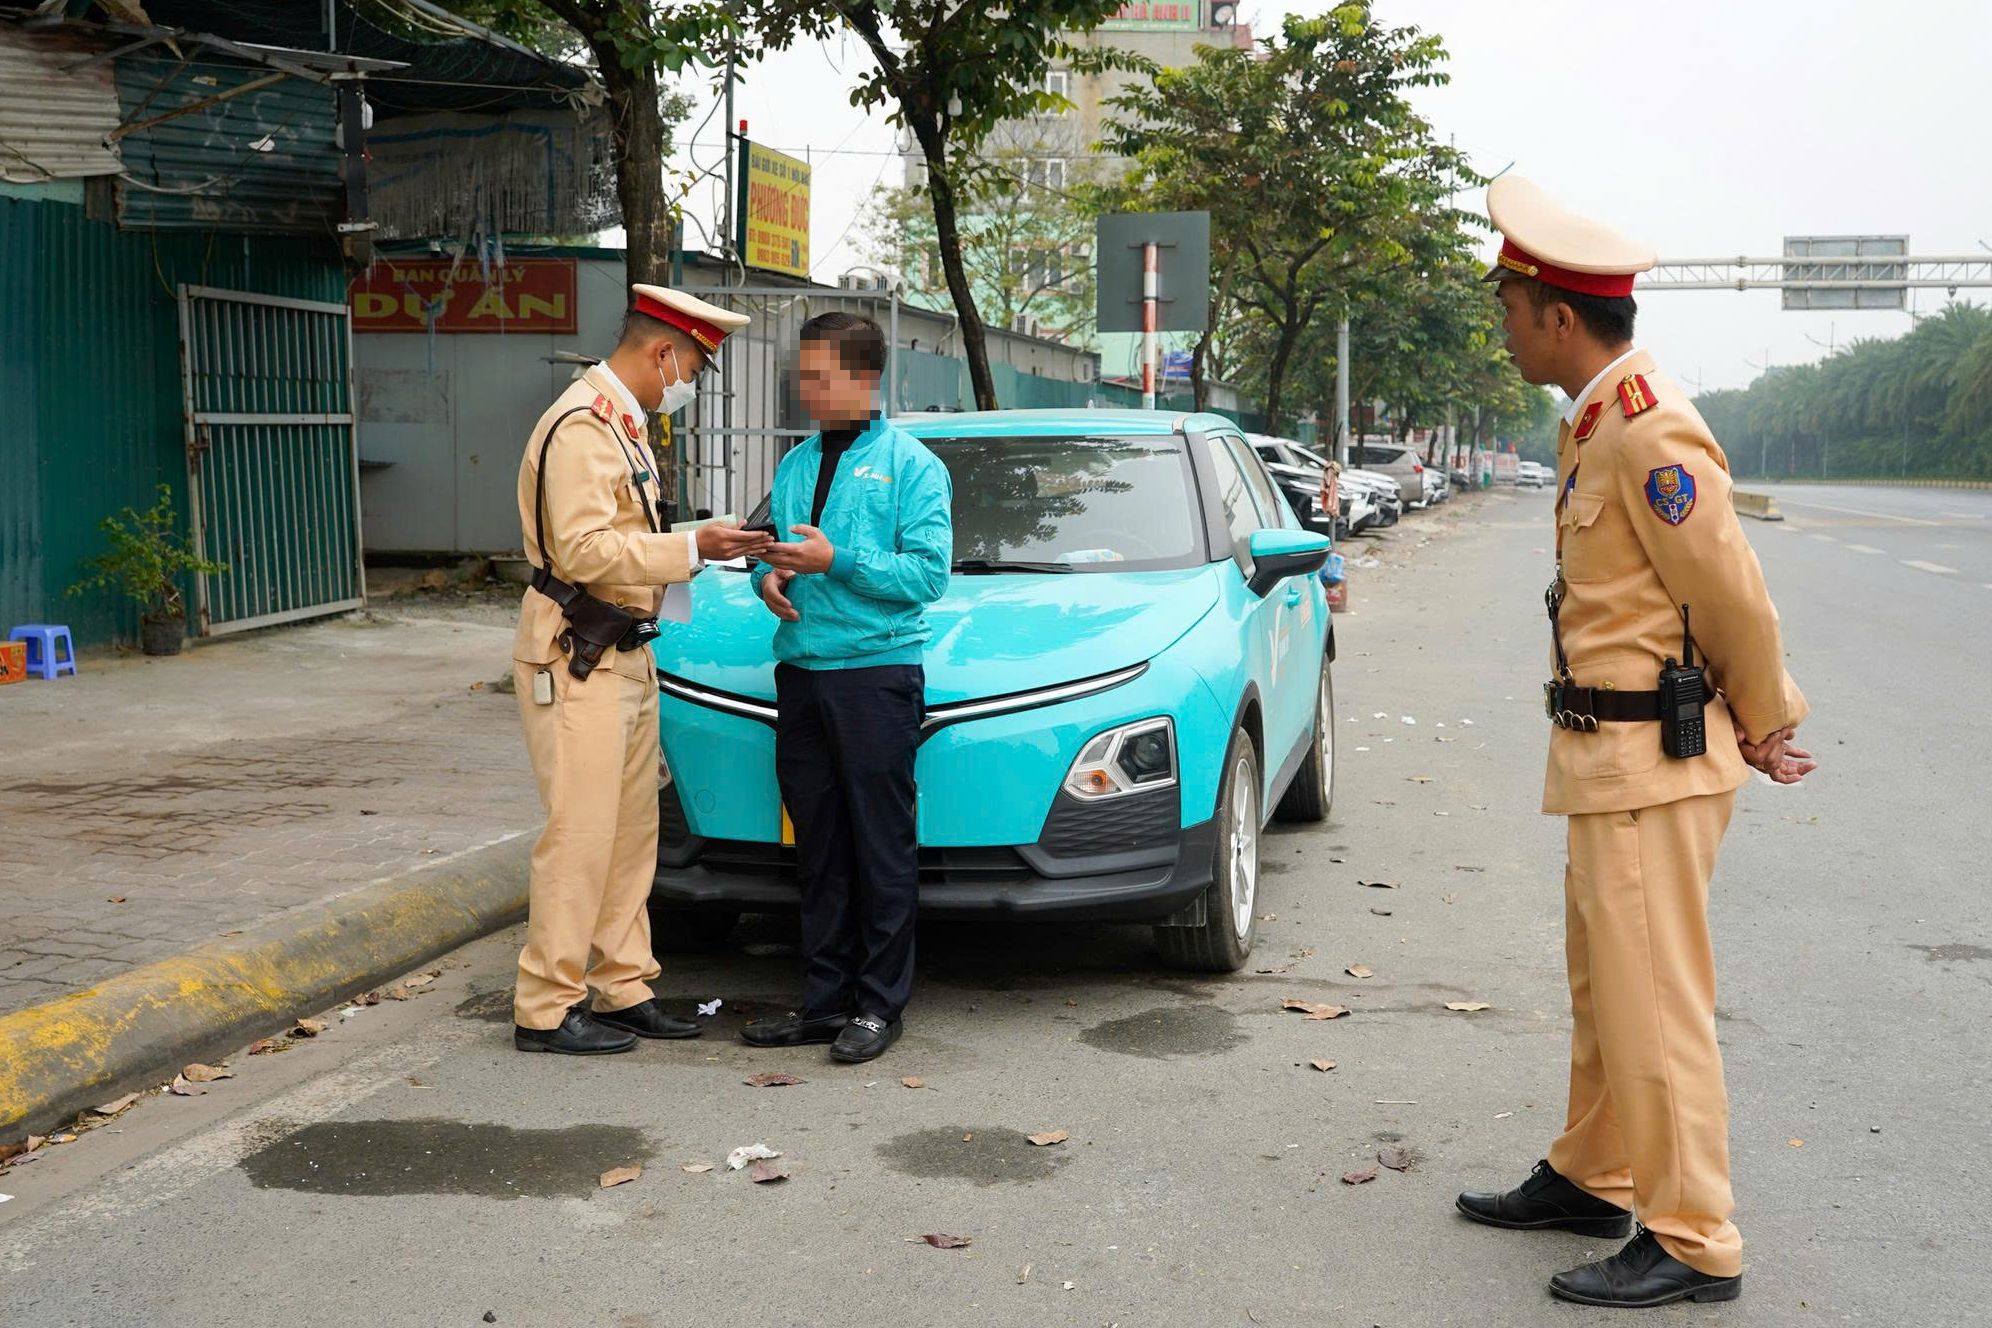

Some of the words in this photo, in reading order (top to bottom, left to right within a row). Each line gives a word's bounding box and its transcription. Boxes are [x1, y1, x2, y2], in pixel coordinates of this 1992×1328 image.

[1152, 3, 1178, 20] ANH
[749, 181, 789, 228] PHƯƠNG
[393, 269, 434, 282] BAN
[438, 265, 496, 282] QUẢN
[502, 265, 528, 282] LÝ
[354, 288, 455, 326] DỰ
[467, 285, 566, 319] ÁN
[1655, 498, 1669, 507] CS
[1674, 493, 1688, 504] GT
